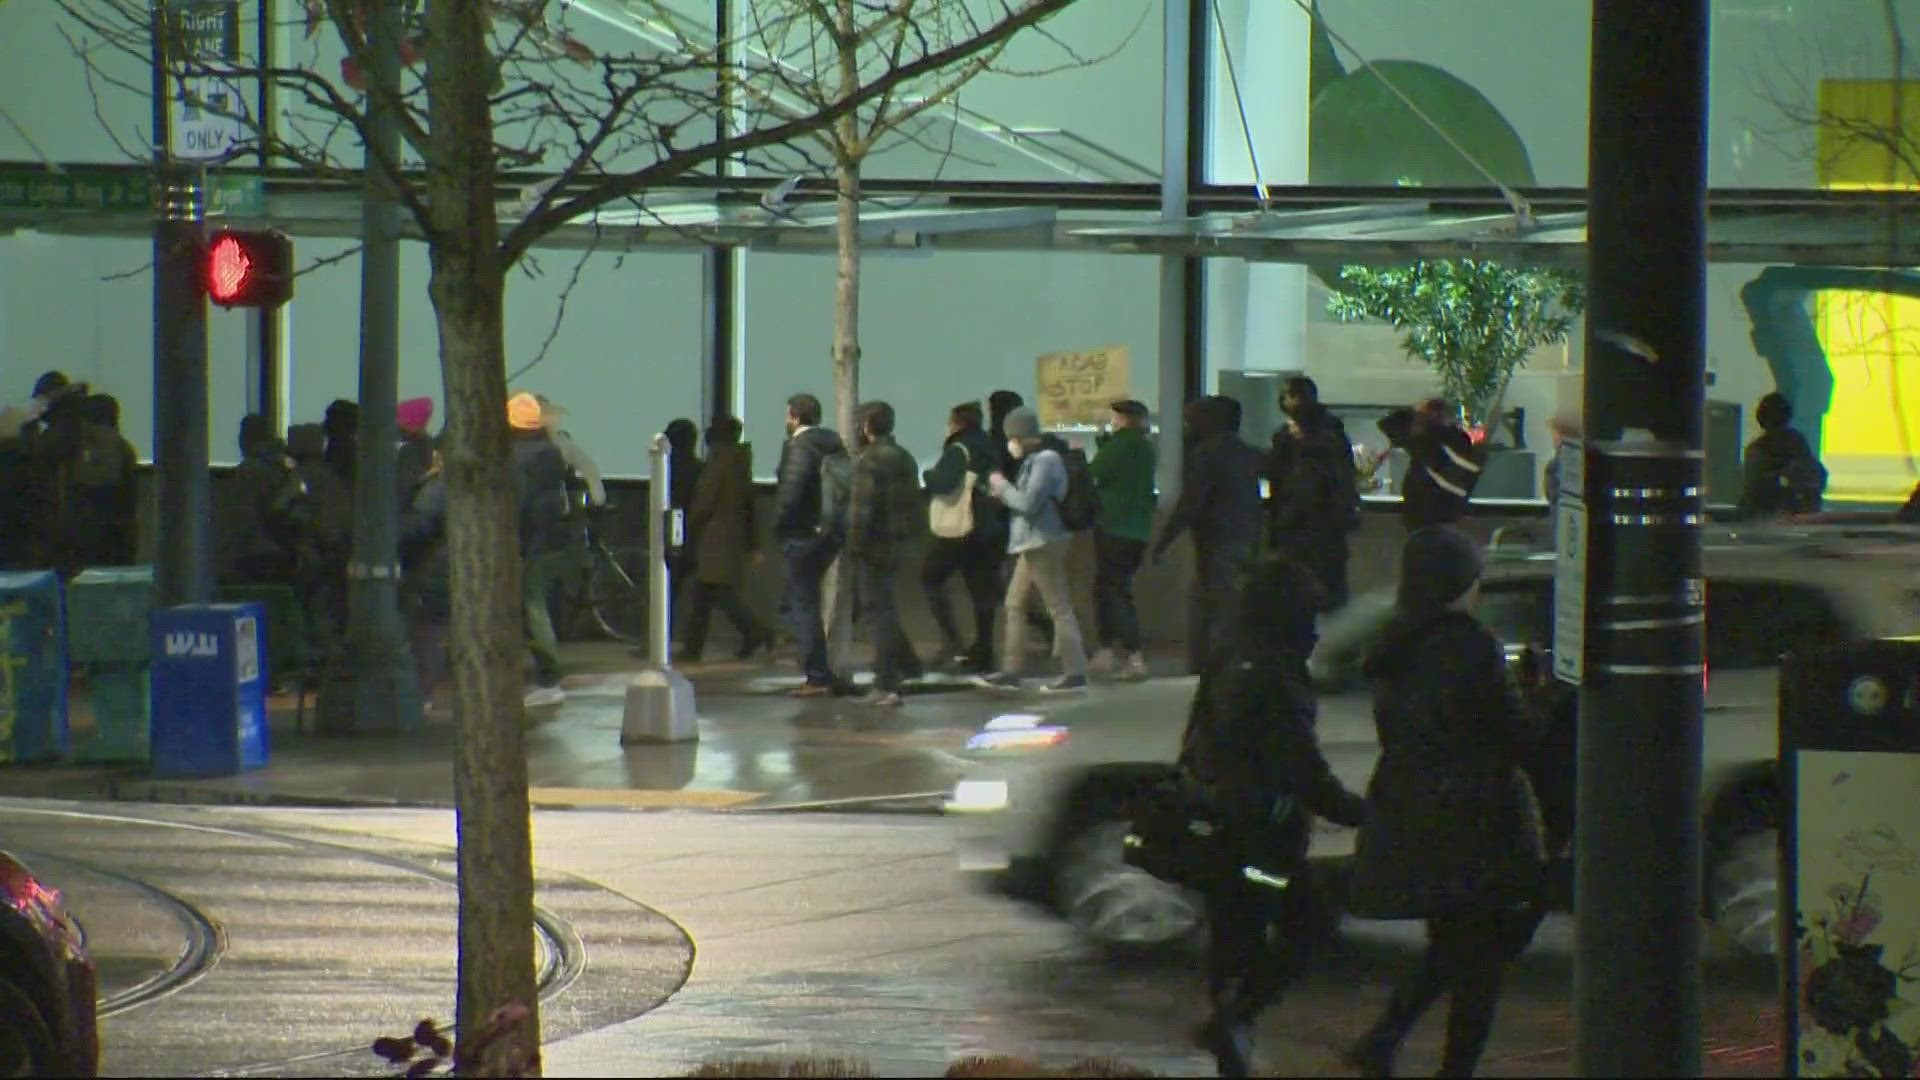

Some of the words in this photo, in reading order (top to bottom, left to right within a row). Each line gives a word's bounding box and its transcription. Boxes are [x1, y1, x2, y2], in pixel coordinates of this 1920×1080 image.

[180, 9, 225, 31] RIGHT
[186, 130, 224, 151] ONLY
[1048, 373, 1106, 397] STOP
